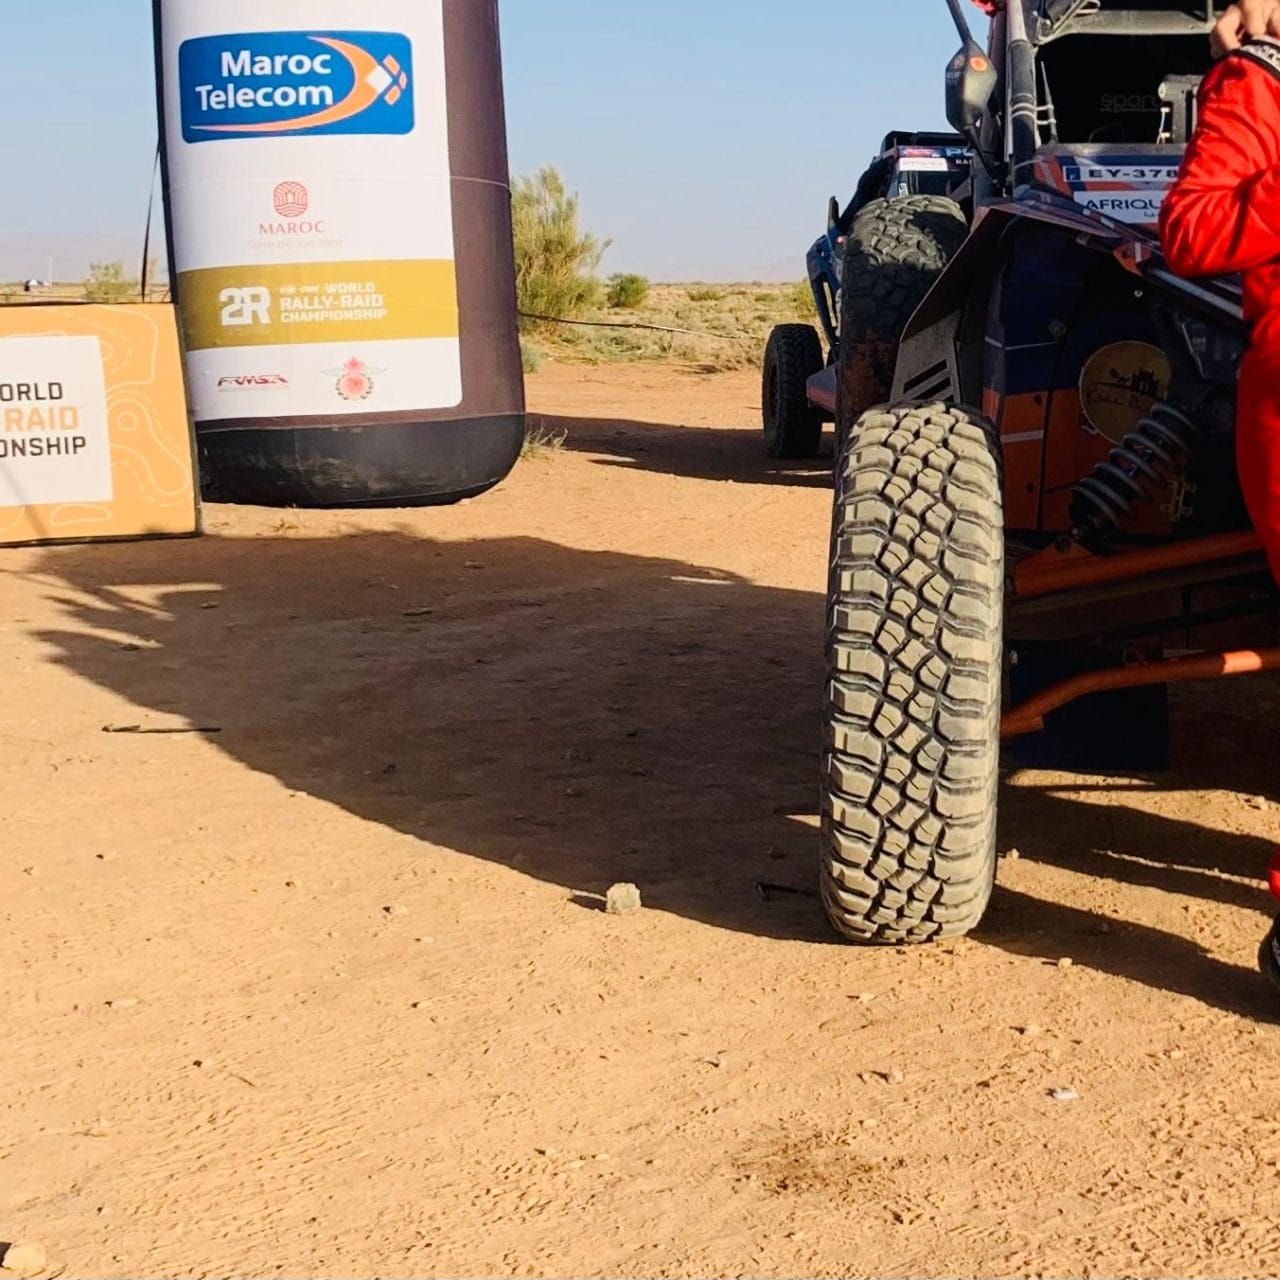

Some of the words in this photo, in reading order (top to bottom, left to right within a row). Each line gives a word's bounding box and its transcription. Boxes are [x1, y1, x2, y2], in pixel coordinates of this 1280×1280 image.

[220, 50, 331, 78] Maroc
[195, 83, 333, 111] Telecom
[1100, 93, 1159, 113] spar
[259, 220, 326, 235] MAROC
[324, 281, 375, 293] WORLD
[219, 286, 272, 327] 2R
[280, 295, 383, 310] RALLY-RAID
[280, 308, 388, 323] CHAMPIONSHIP
